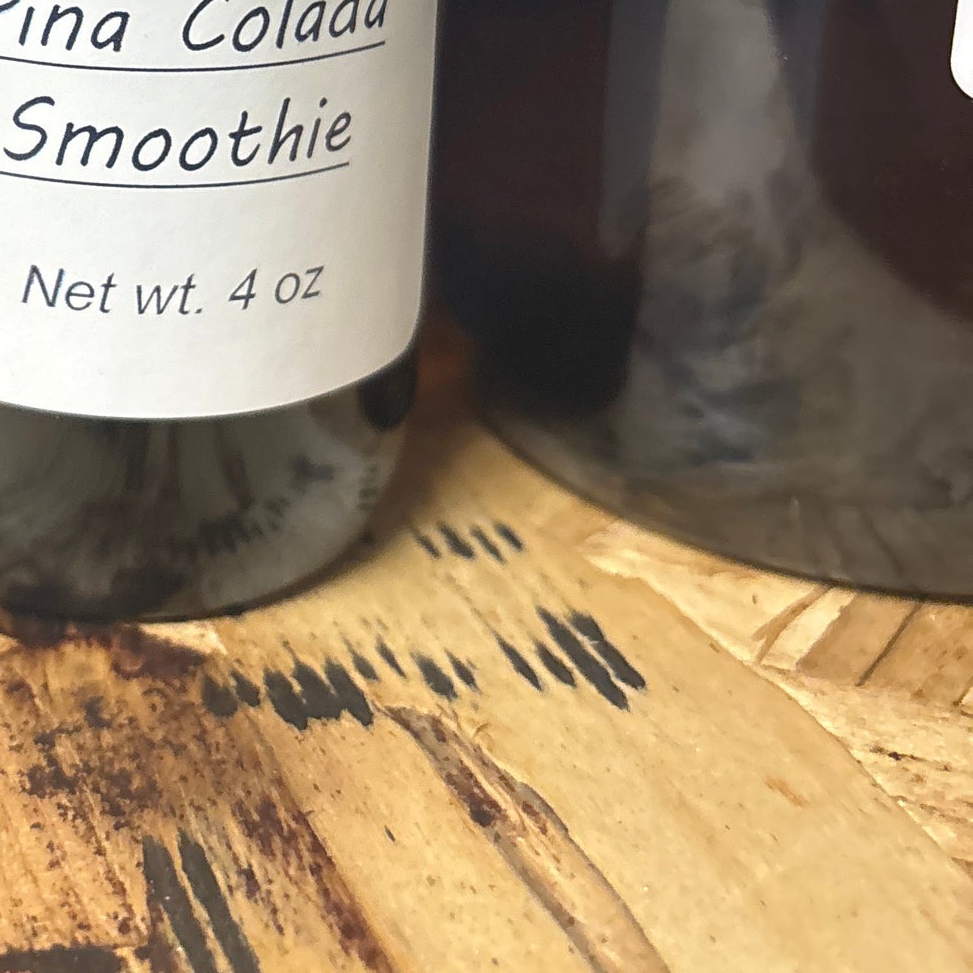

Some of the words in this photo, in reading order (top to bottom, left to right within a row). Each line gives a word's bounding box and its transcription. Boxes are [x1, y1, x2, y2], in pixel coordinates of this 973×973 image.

[2, 95, 353, 172] Smoothie
[21, 264, 117, 314] Net
[135, 270, 204, 315] wt.
[228, 268, 257, 311] 4
[273, 263, 326, 304] oz
